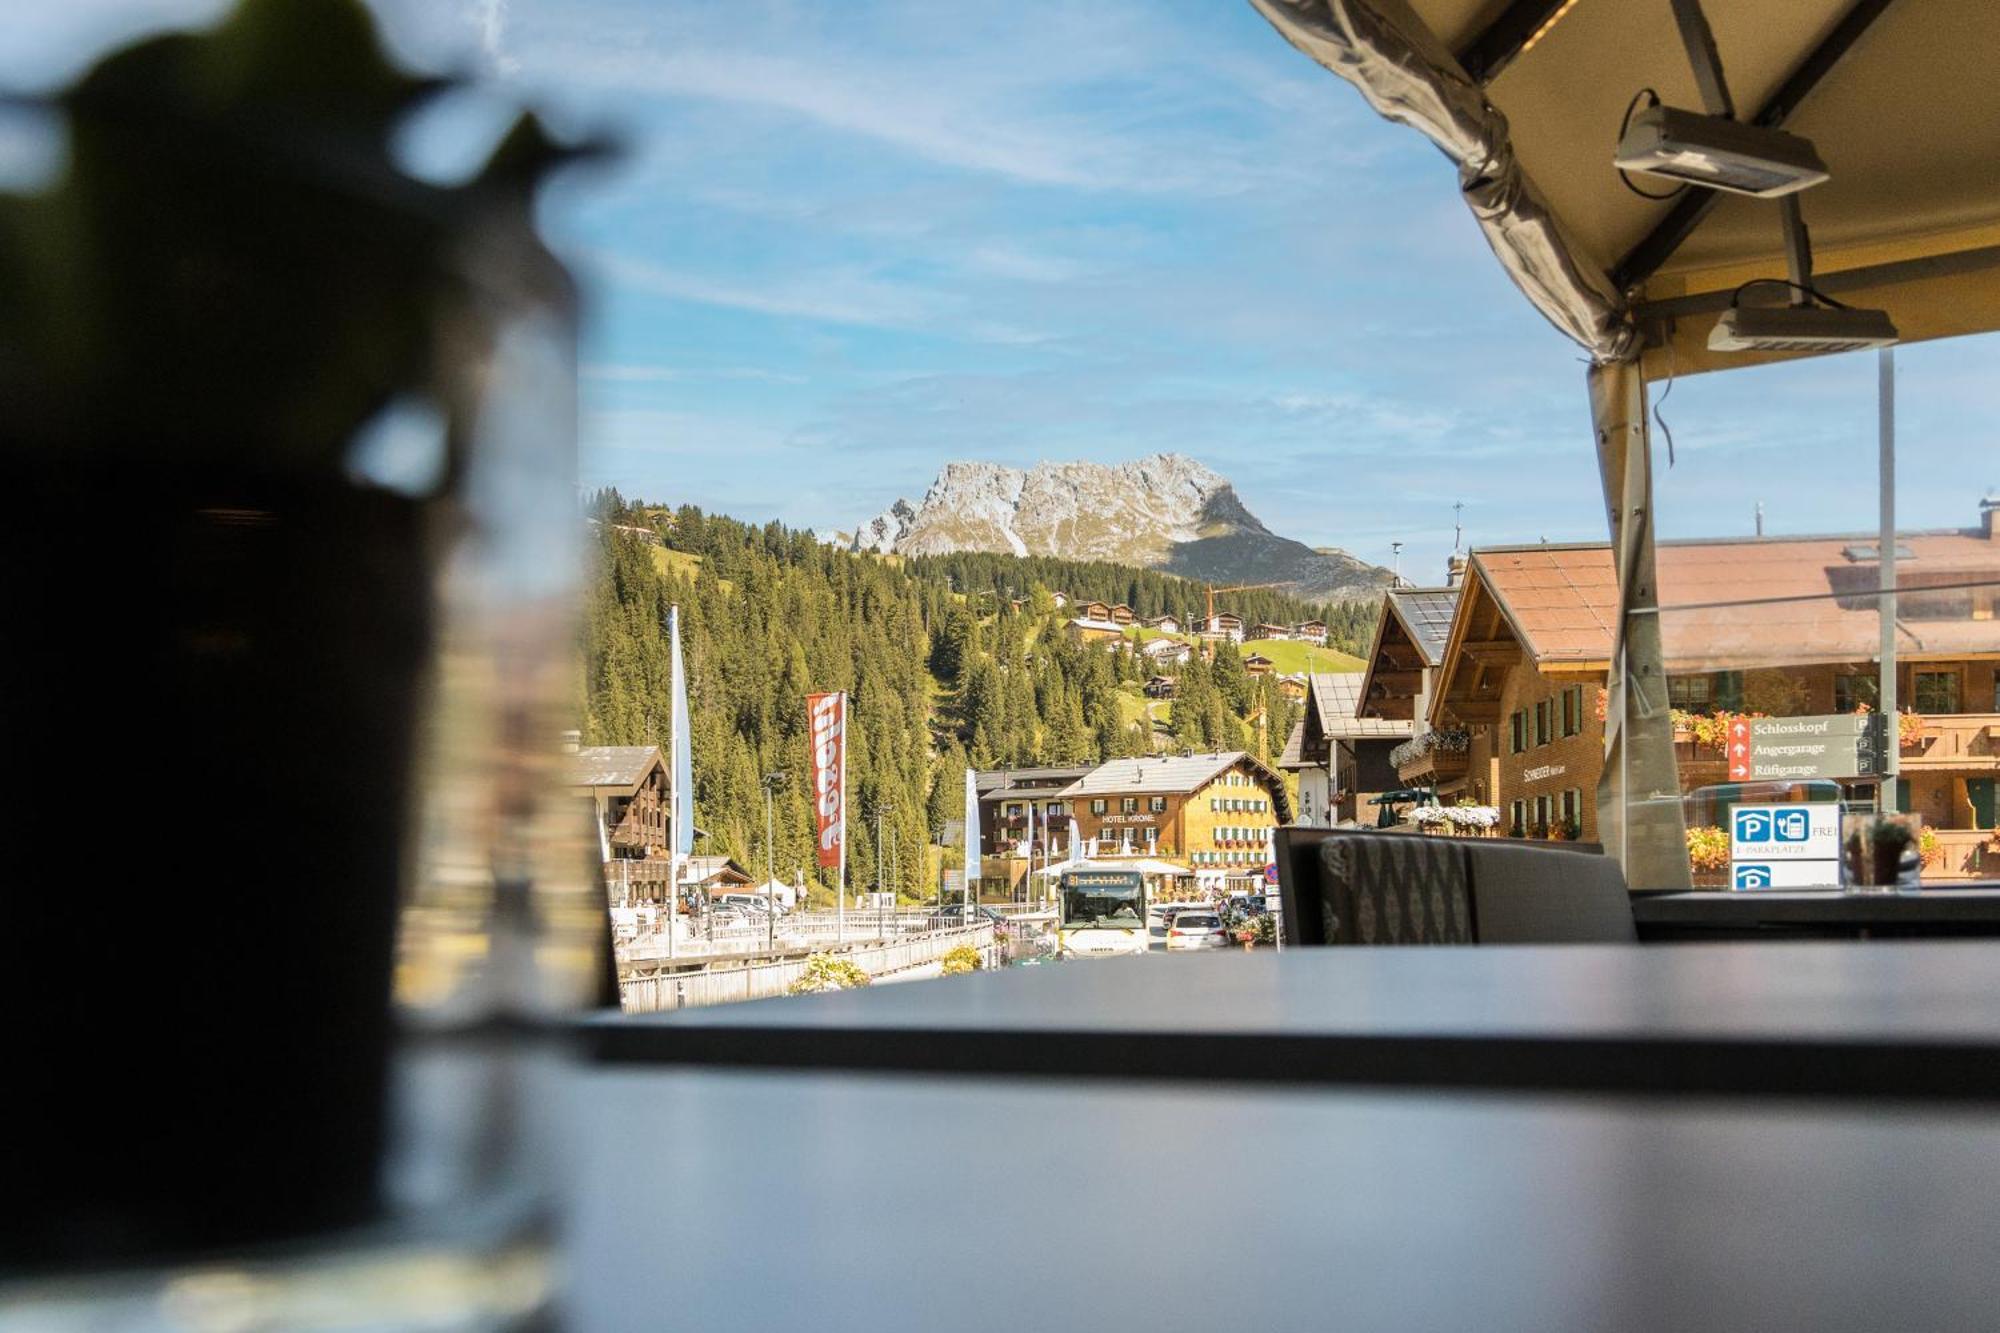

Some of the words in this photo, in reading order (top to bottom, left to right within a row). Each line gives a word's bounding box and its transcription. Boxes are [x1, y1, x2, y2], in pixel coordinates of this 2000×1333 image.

[1753, 720, 1829, 736] Schlosskopf
[1753, 743, 1826, 757] Angergarage
[1754, 763, 1818, 777] Rüfigarage
[1102, 815, 1127, 824] HOTEL
